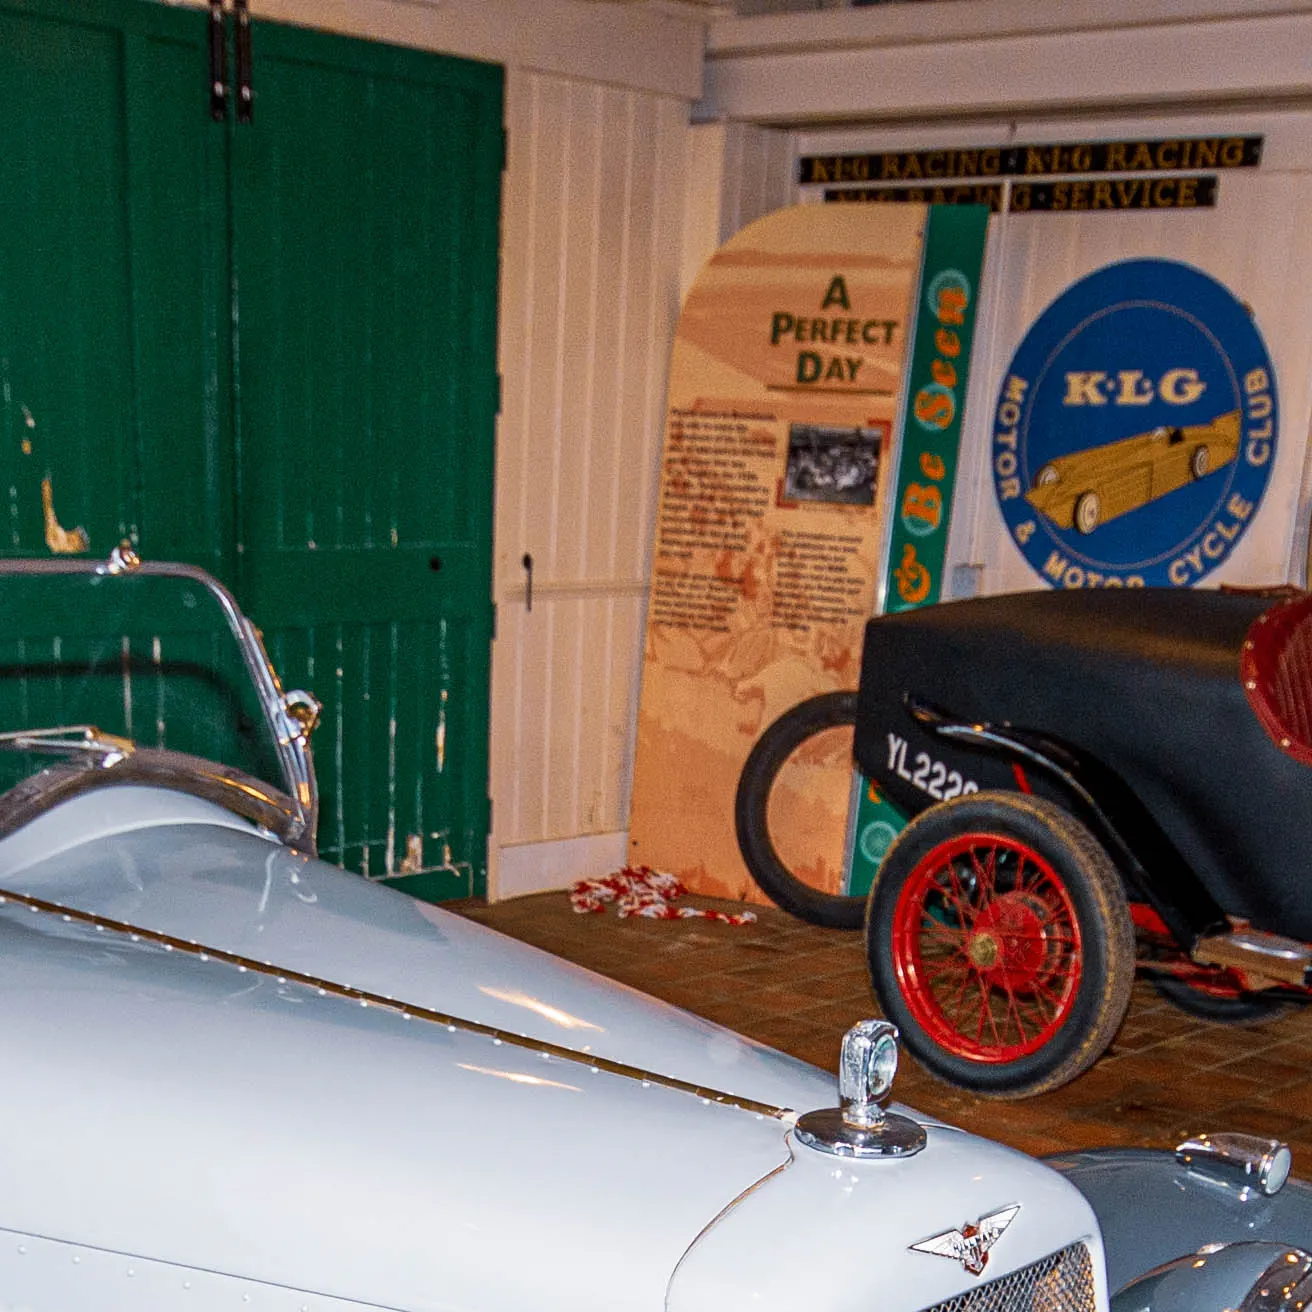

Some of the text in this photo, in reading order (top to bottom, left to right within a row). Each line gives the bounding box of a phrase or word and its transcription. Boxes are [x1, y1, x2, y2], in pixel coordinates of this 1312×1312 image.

[881, 148, 1000, 182] RACING
[1105, 137, 1246, 171] RACING
[1052, 177, 1199, 210] SERVICE
[821, 274, 850, 310] A
[914, 286, 968, 431] Seen
[901, 452, 946, 529] Be
[995, 375, 1029, 501] MOTOR
[1168, 492, 1255, 586] CYCLE
[1244, 367, 1274, 468] CLUB
